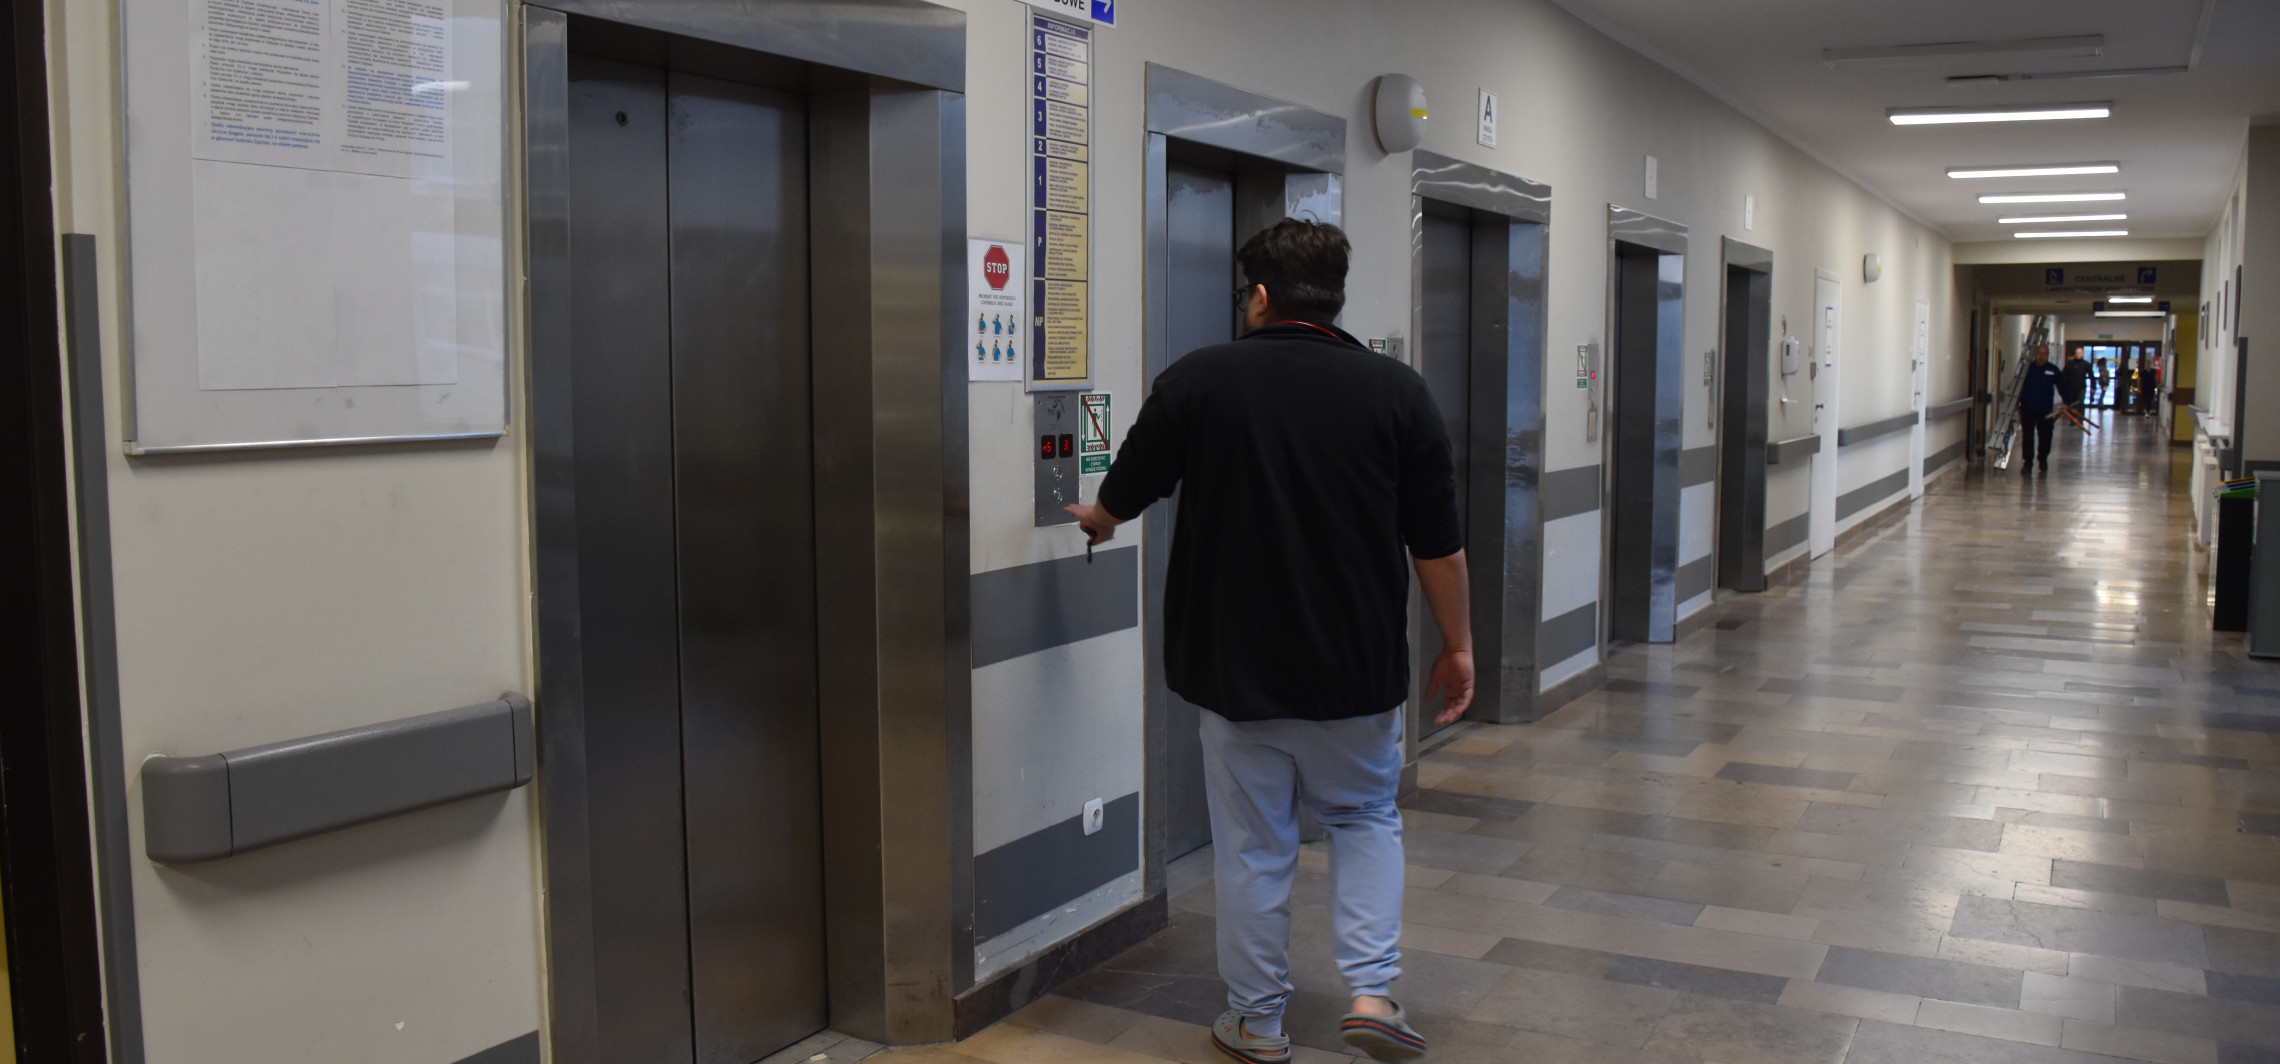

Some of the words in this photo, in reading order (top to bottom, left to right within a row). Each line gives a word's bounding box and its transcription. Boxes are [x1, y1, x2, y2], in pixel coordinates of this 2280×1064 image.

[1047, 22, 1076, 35] INFORMACJA
[1036, 35, 1042, 46] 6
[1037, 58, 1042, 68] 5
[1037, 81, 1042, 92] 4
[1484, 95, 1492, 123] A
[1037, 111, 1042, 122] 3
[1038, 140, 1043, 151] 2
[1038, 175, 1042, 186] 1
[1038, 236, 1042, 247] P
[986, 262, 1008, 274] STOP
[2074, 274, 2126, 282] CENTRALNE
[1034, 316, 1044, 327] NP
[1063, 439, 1069, 451] 3
